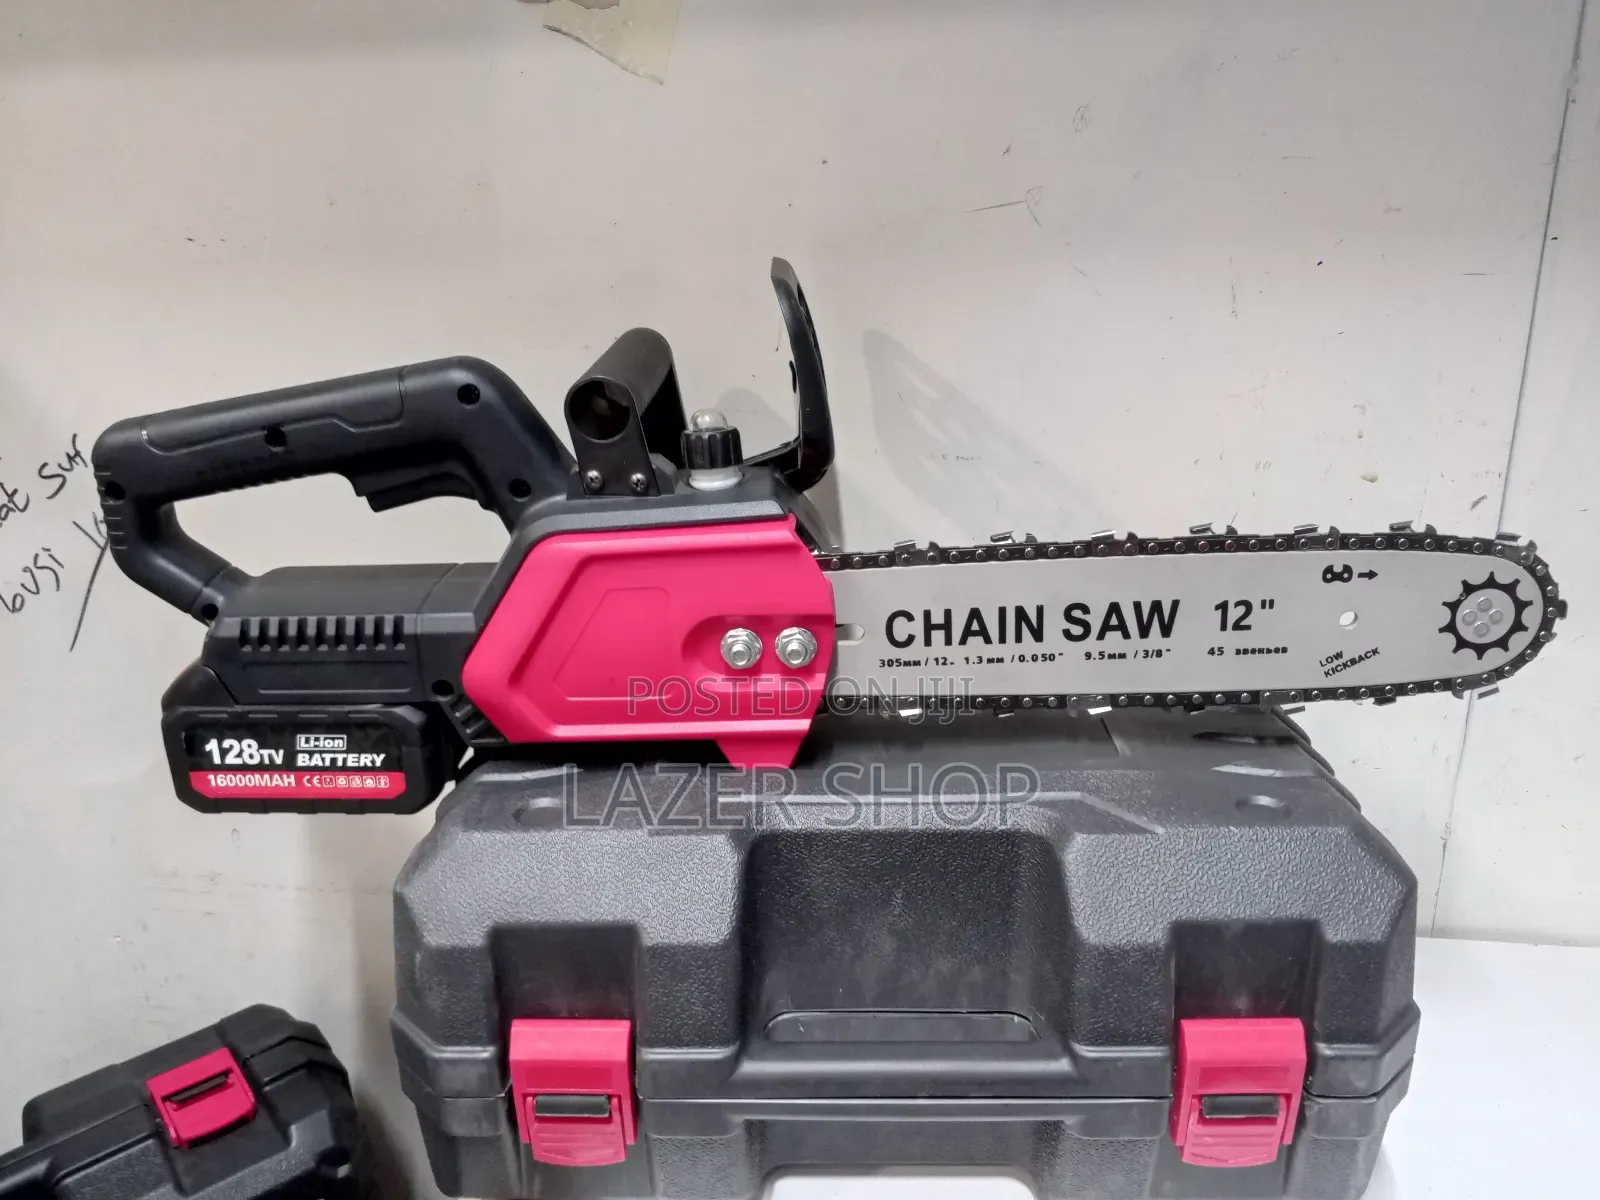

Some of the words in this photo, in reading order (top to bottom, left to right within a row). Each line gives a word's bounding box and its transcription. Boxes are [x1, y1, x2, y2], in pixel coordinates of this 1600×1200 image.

[885, 604, 1045, 649] CHAIN
[1061, 598, 1181, 642] SAW
[1214, 598, 1275, 632] 12"
[1207, 646, 1225, 656] 45
[1319, 650, 1344, 668] LOW
[1323, 646, 1382, 679] KICKBACK
[204, 738, 285, 766] 128TV
[296, 752, 387, 768] BATTERY
[206, 773, 297, 788] 16000MAH
